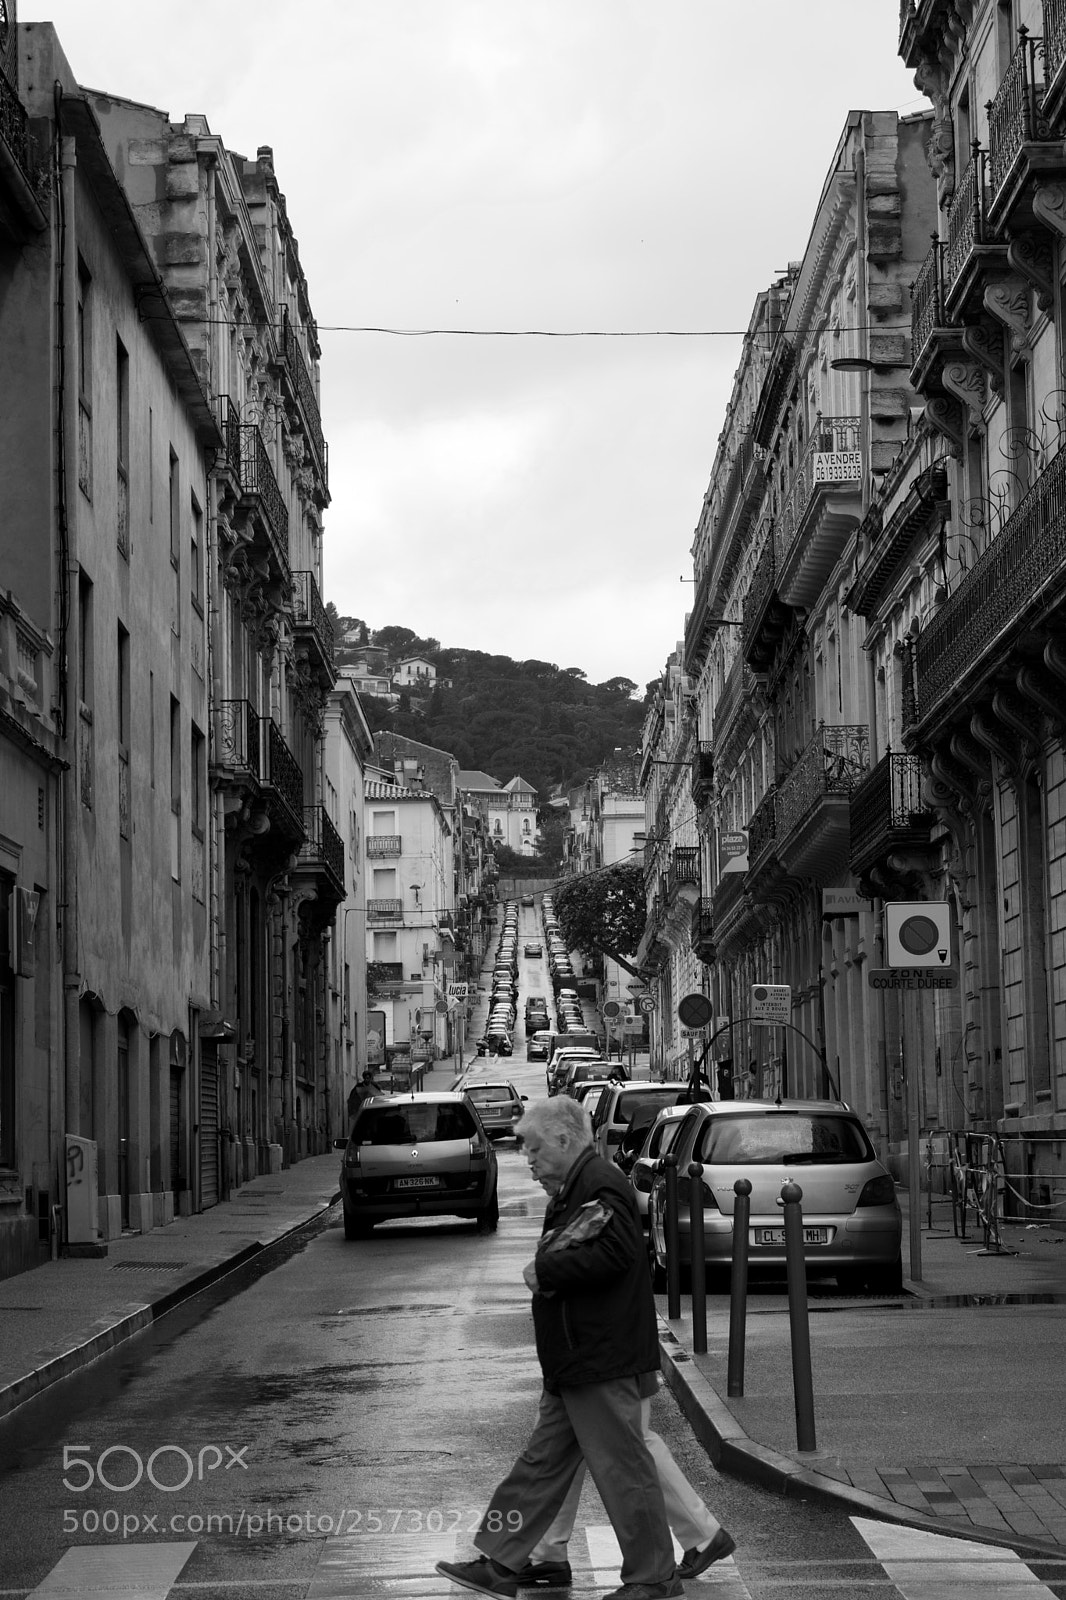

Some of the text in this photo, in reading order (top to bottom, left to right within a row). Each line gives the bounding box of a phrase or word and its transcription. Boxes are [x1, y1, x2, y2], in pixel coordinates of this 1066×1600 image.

[824, 453, 861, 464] VENDRE
[721, 834, 743, 845] plaza
[889, 969, 933, 978] ZONE
[873, 976, 952, 989] COURTE DURÉE
